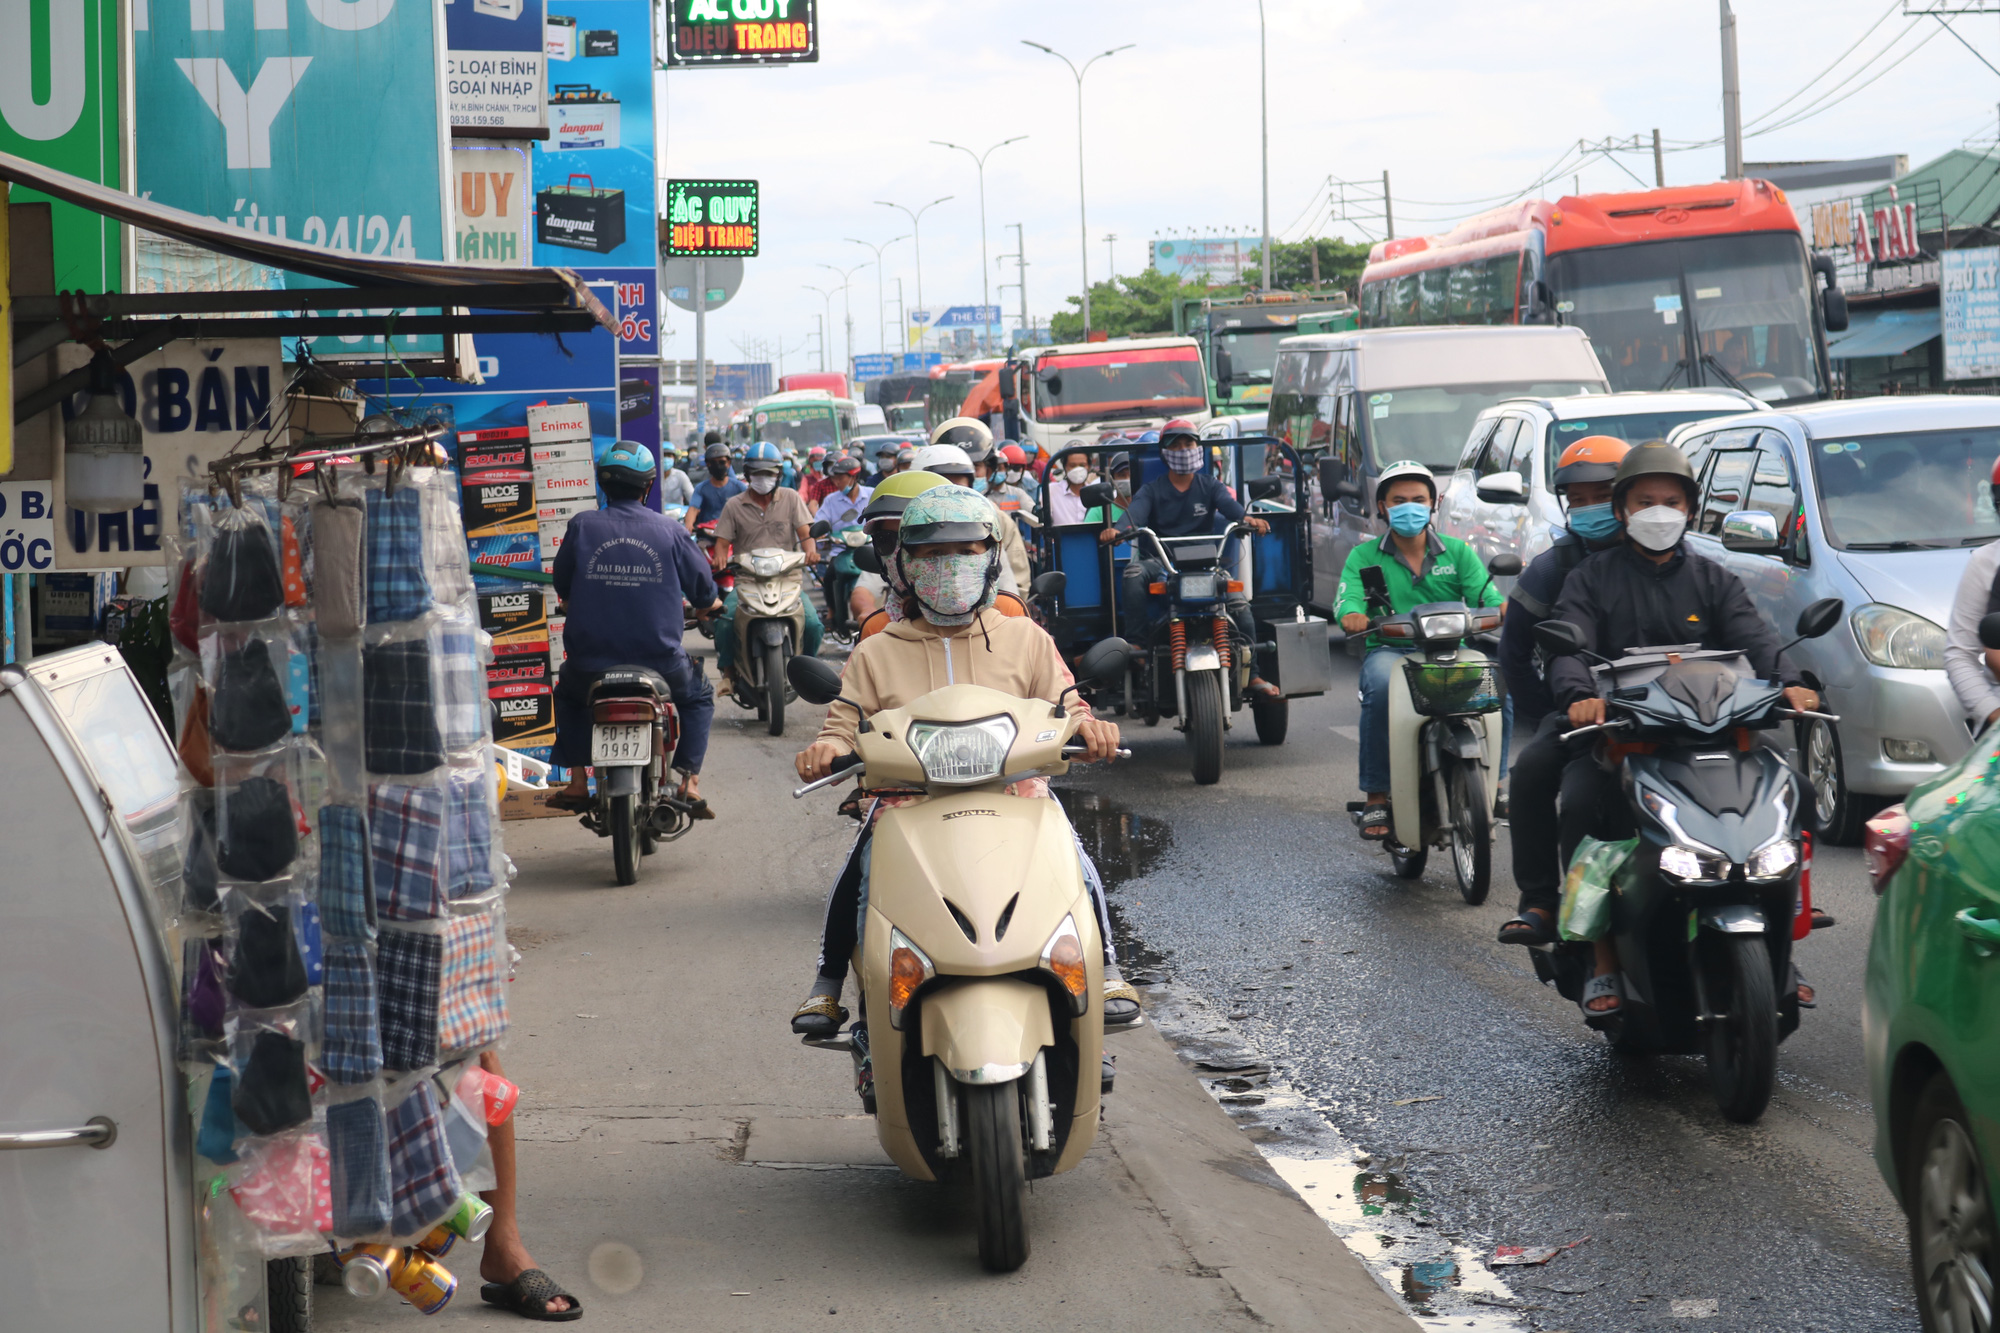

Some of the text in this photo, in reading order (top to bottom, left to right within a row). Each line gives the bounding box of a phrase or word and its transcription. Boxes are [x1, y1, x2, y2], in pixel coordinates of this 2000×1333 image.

[734, 22, 807, 50] TRANG
[460, 60, 496, 78] LOẠI
[500, 57, 537, 76] BÌNH
[491, 79, 533, 99] NHẬP
[174, 56, 314, 169] Y
[513, 104, 537, 113] TP.HCM
[453, 172, 515, 218] UY
[708, 196, 753, 224] QUY
[673, 222, 753, 251] DIỆU TRANG
[157, 347, 271, 433] BÁN
[541, 421, 583, 432] Enimac
[465, 452, 525, 467] SOLITE
[481, 485, 519, 498] INCOE
[546, 478, 589, 489] Enimac
[21, 491, 53, 519] B
[633, 564, 651, 574] HÒA
[491, 594, 530, 608] INCOE
[487, 666, 545, 679] SOLITE
[500, 699, 538, 711] INCOE
